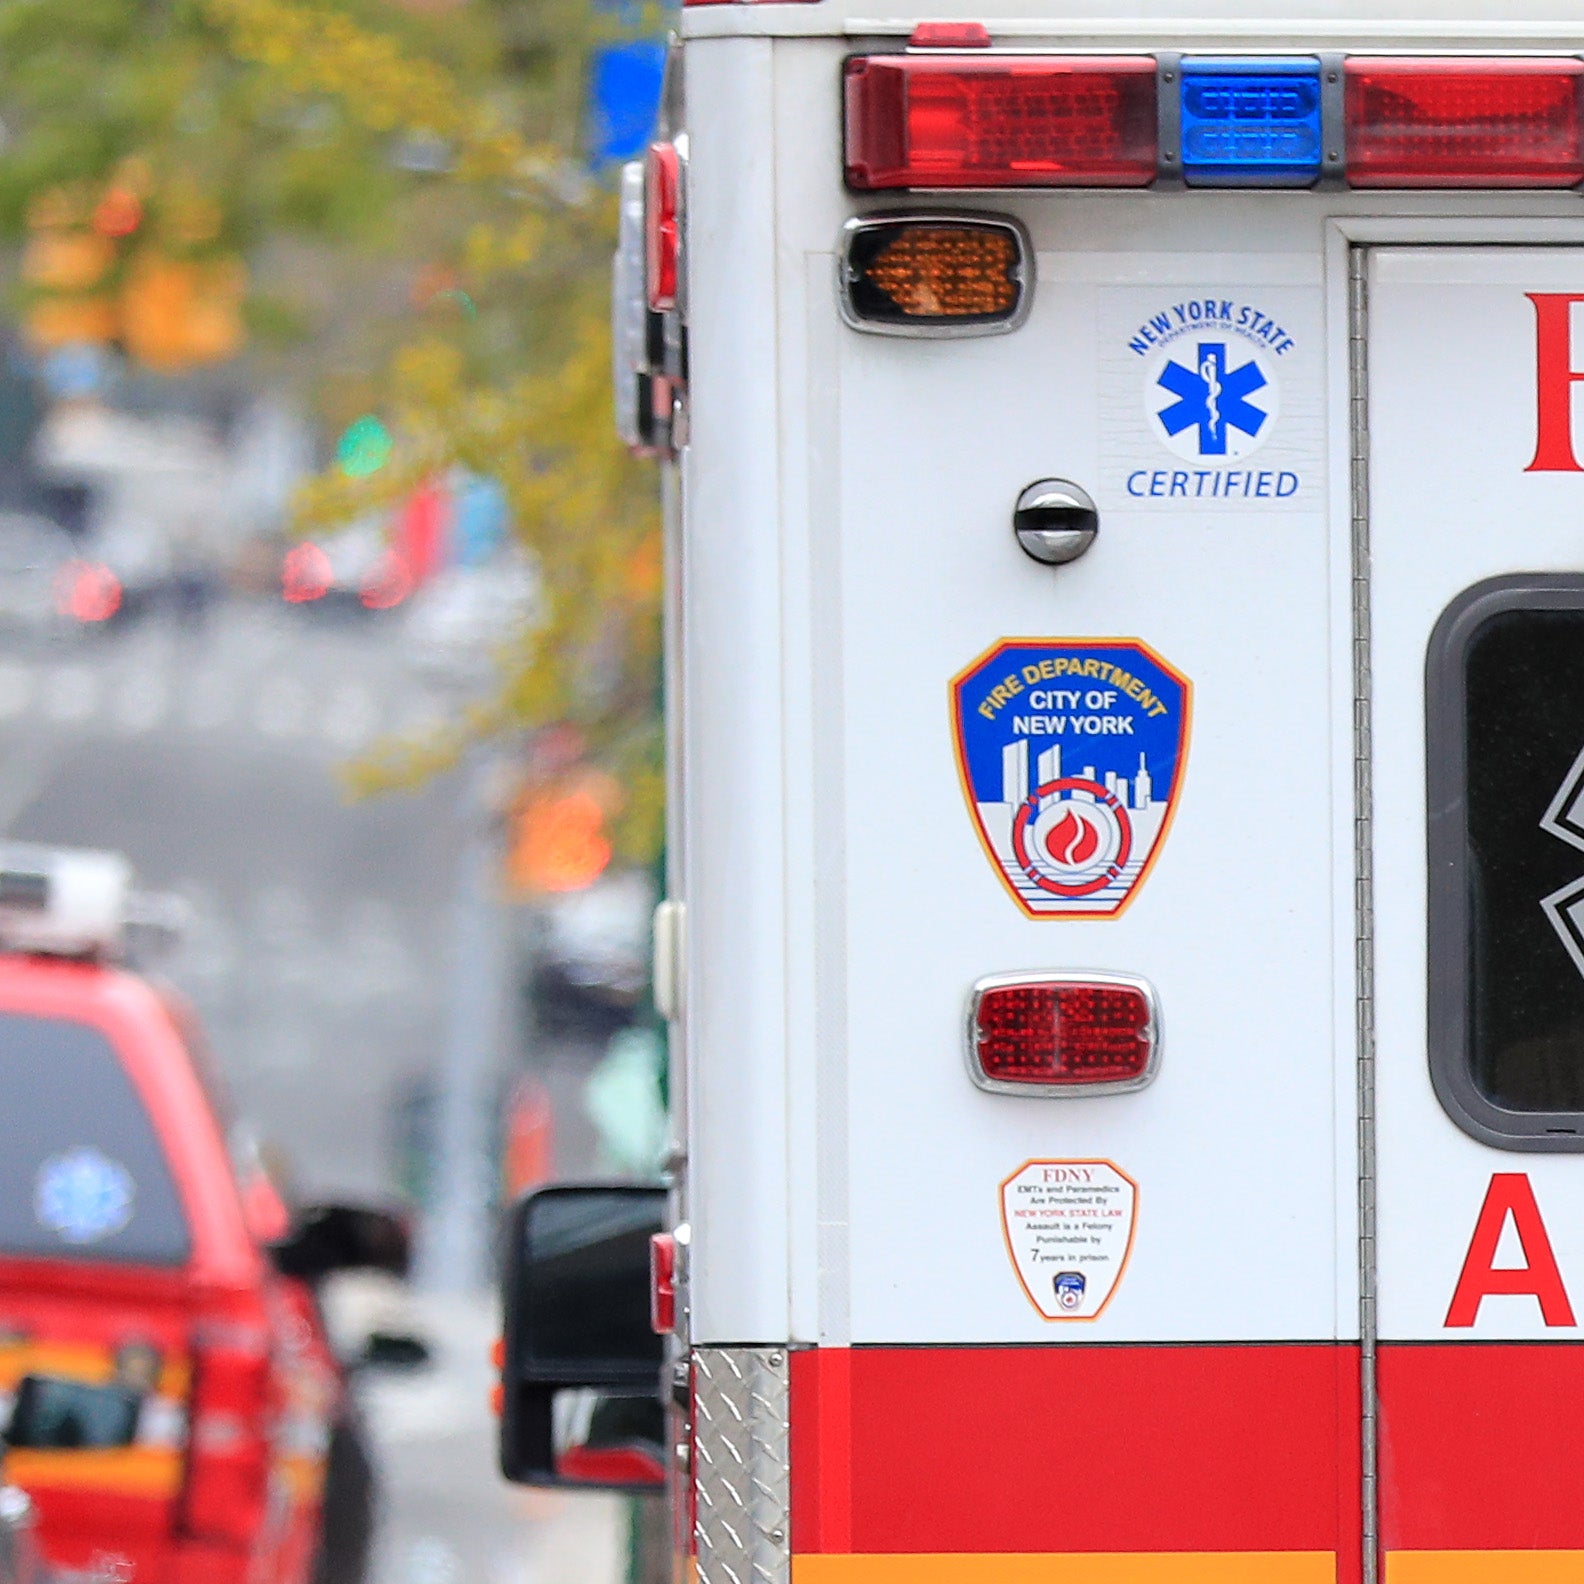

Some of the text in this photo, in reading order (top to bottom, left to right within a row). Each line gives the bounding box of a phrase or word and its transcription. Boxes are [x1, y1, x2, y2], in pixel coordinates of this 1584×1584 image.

[1127, 300, 1295, 357] NEW YORK STATE
[1127, 470, 1299, 497] CERTIFIED
[977, 657, 1168, 720] FIRE DEPARTMENT
[1029, 691, 1118, 710] CITY OF
[1013, 716, 1134, 735] NEW YORK
[1043, 1169, 1094, 1182] FDNY
[1031, 1248, 1040, 1261] 7
